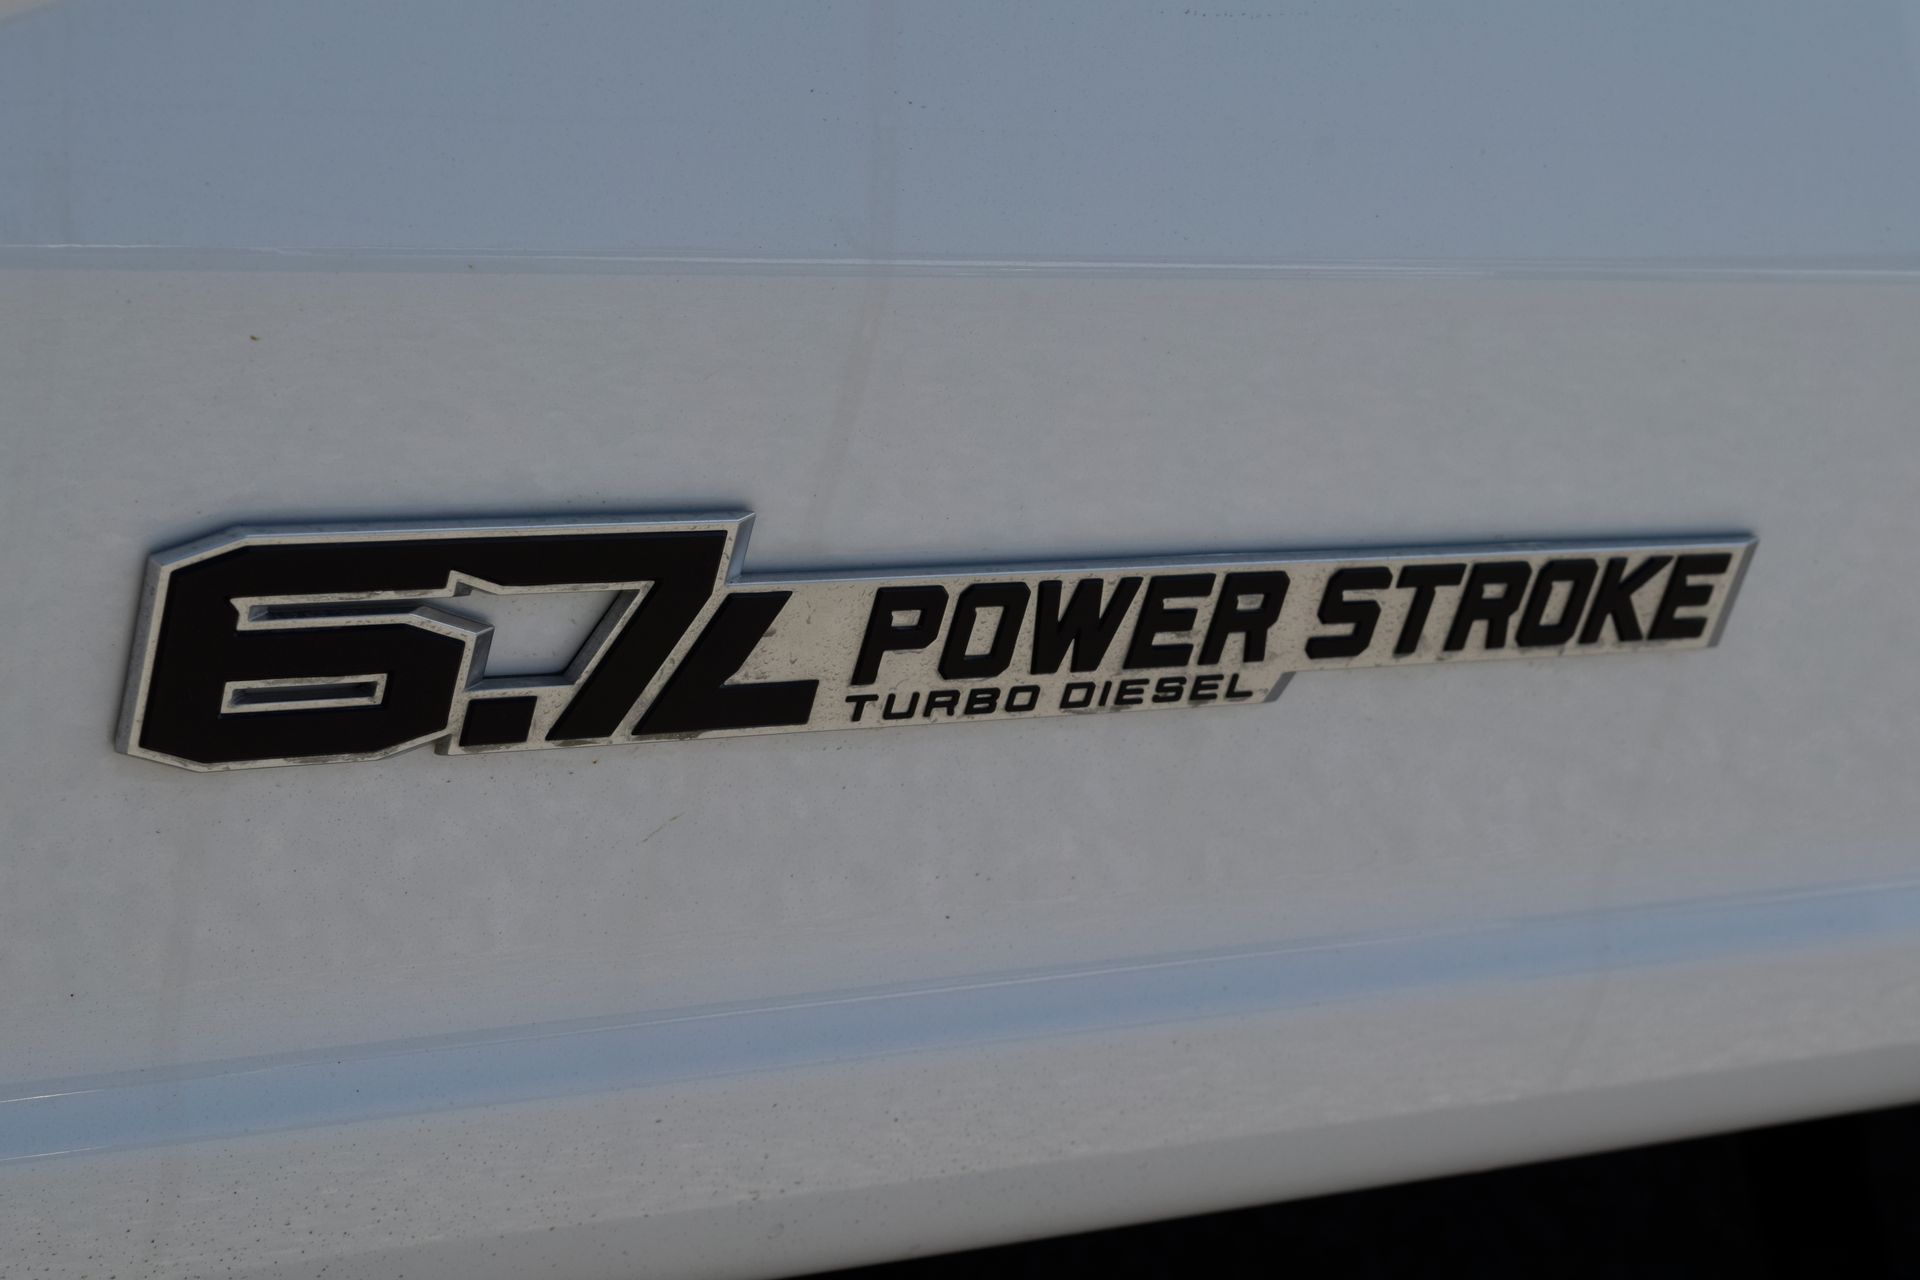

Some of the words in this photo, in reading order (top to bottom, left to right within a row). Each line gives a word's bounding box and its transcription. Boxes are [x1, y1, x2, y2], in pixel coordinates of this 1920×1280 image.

[138, 530, 820, 763] 6.7L
[851, 570, 1291, 686] POWER
[1305, 553, 1733, 660] STROKE
[845, 685, 1041, 722] TURBO
[1059, 673, 1254, 710] DIESEL
